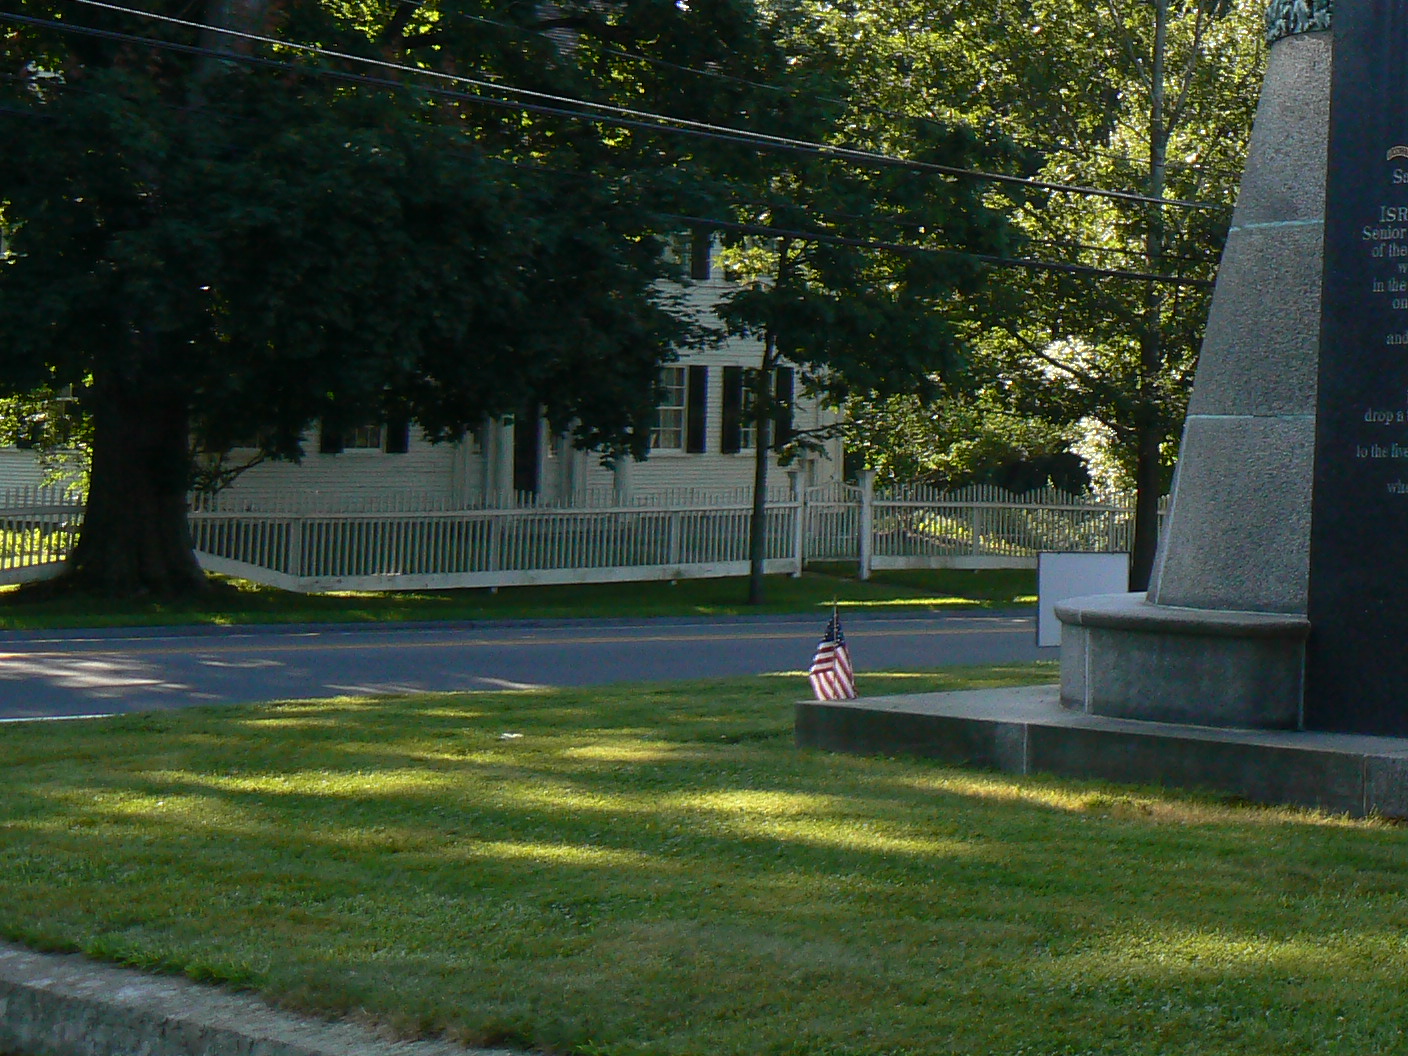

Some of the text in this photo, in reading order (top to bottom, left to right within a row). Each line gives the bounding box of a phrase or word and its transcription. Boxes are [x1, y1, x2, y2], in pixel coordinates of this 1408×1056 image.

[1362, 225, 1407, 241] Senior
[1372, 243, 1386, 258] of
[1388, 243, 1408, 257] the
[1373, 277, 1384, 292] in
[1387, 277, 1407, 291] the
[1392, 297, 1408, 309] on
[1386, 330, 1408, 344] and
[1364, 407, 1394, 425] drop
[1371, 444, 1388, 458] the
